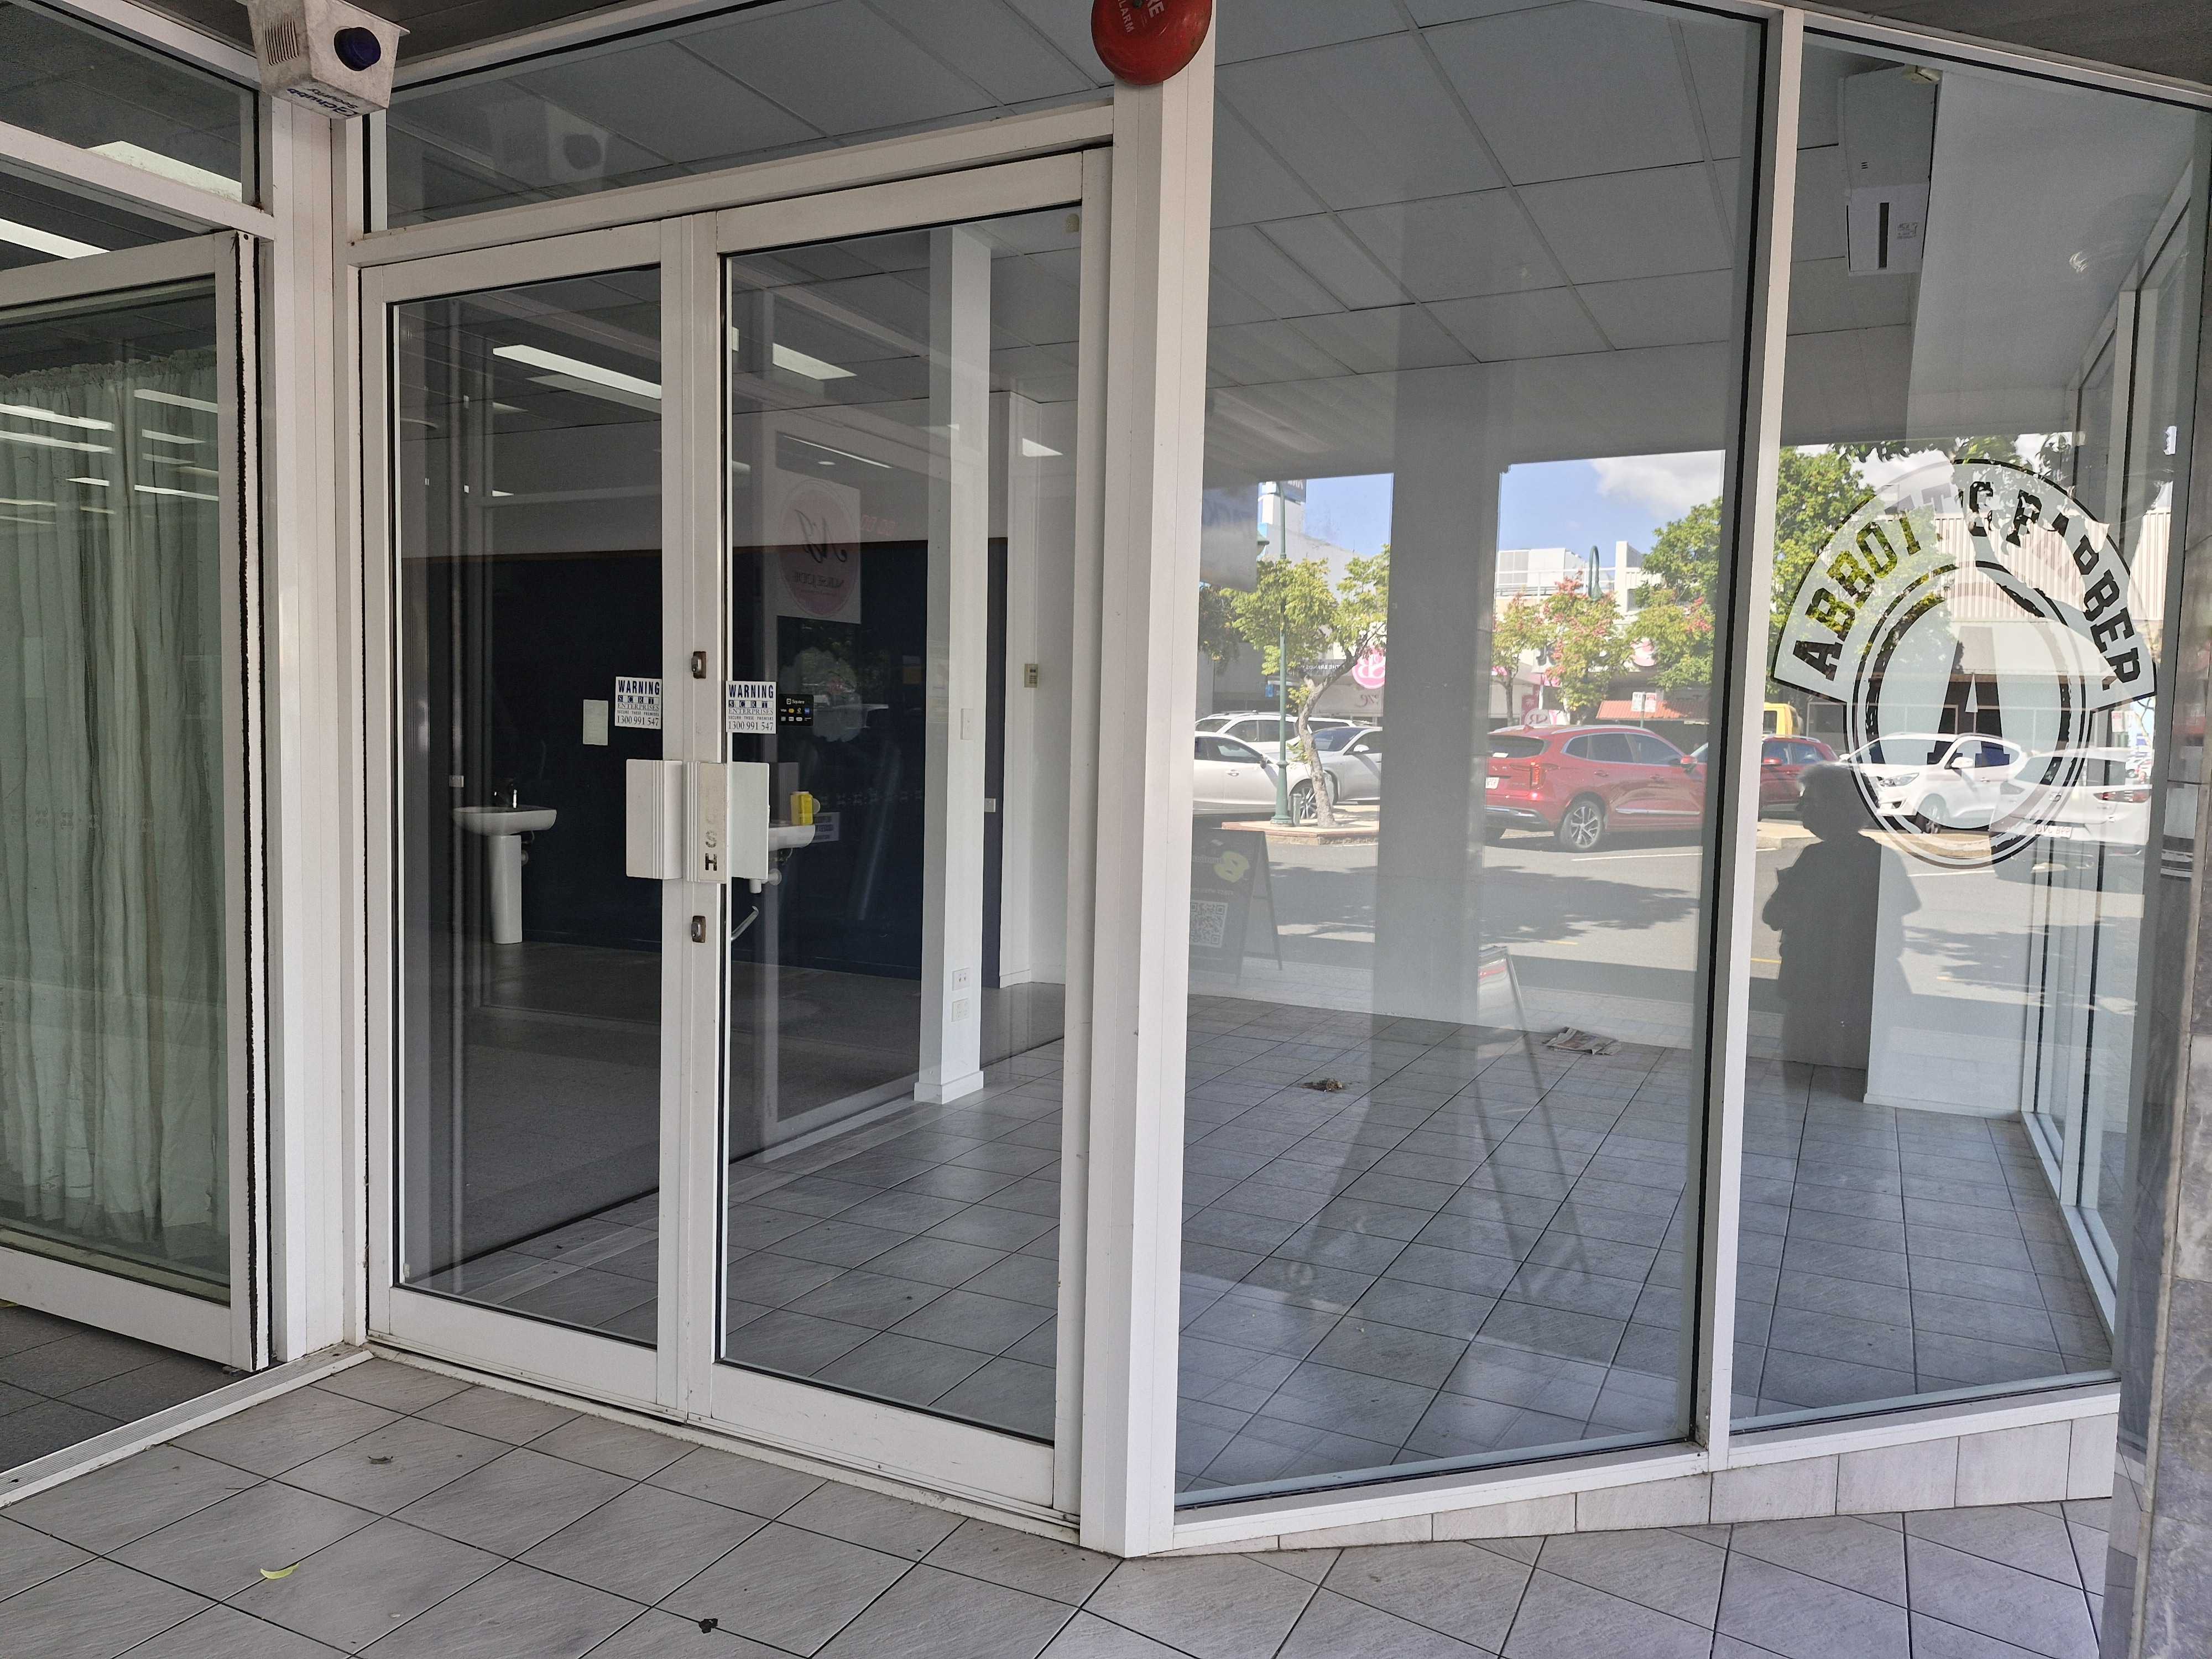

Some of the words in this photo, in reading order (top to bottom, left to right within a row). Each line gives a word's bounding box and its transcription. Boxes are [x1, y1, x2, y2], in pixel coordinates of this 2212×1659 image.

[1118, 0, 1135, 33] LARM
[286, 88, 337, 109] Chubb
[307, 88, 358, 109] Security
[618, 680, 660, 695] WARNING
[729, 684, 774, 698] WARNING
[618, 716, 632, 724] 1300
[634, 716, 645, 725] 991
[647, 717, 659, 726] 547
[729, 721, 744, 730] 1300
[746, 722, 758, 730] 991
[761, 722, 773, 731] 547
